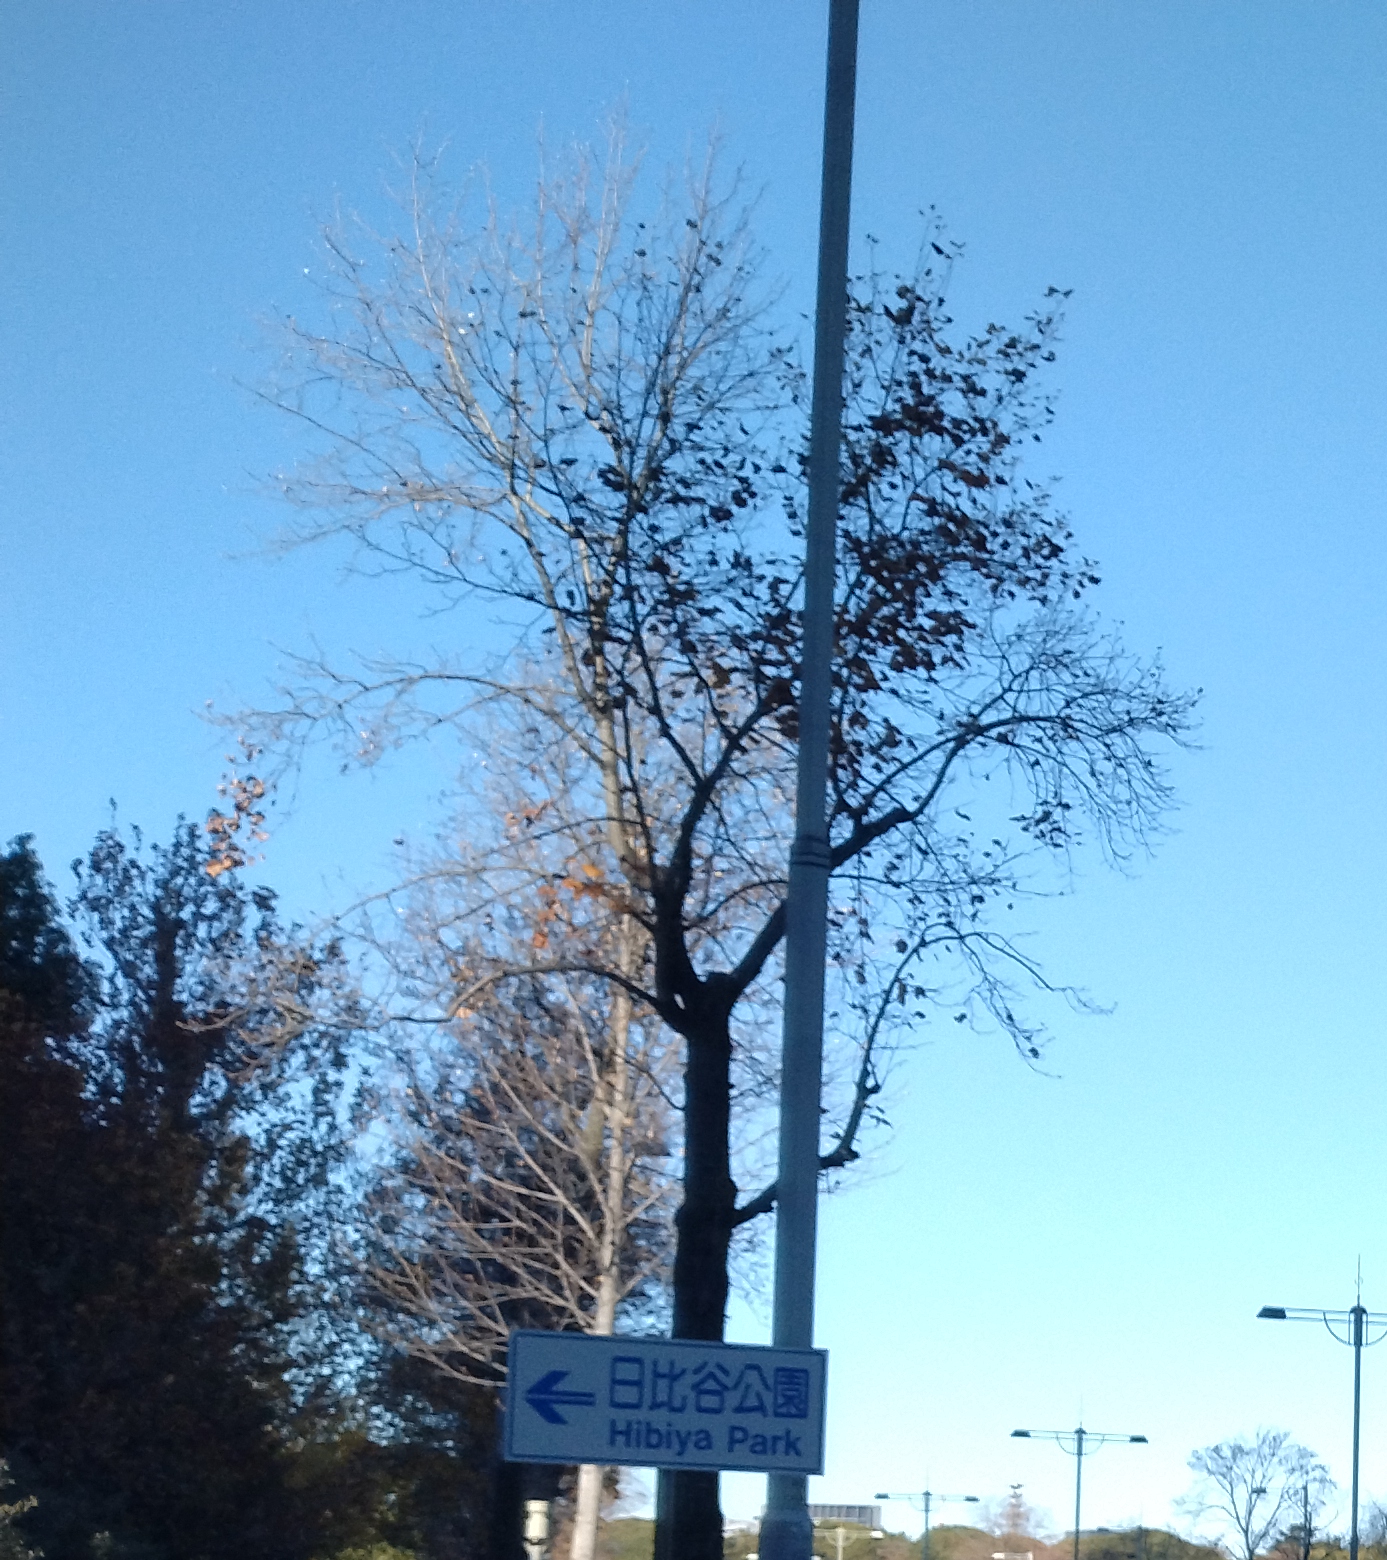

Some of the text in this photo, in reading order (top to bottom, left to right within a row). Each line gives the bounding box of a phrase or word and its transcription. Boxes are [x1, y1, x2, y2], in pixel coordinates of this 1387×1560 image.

[608, 1355, 810, 1419] 日比谷公園
[608, 1418, 802, 1458] Hibiya Park
